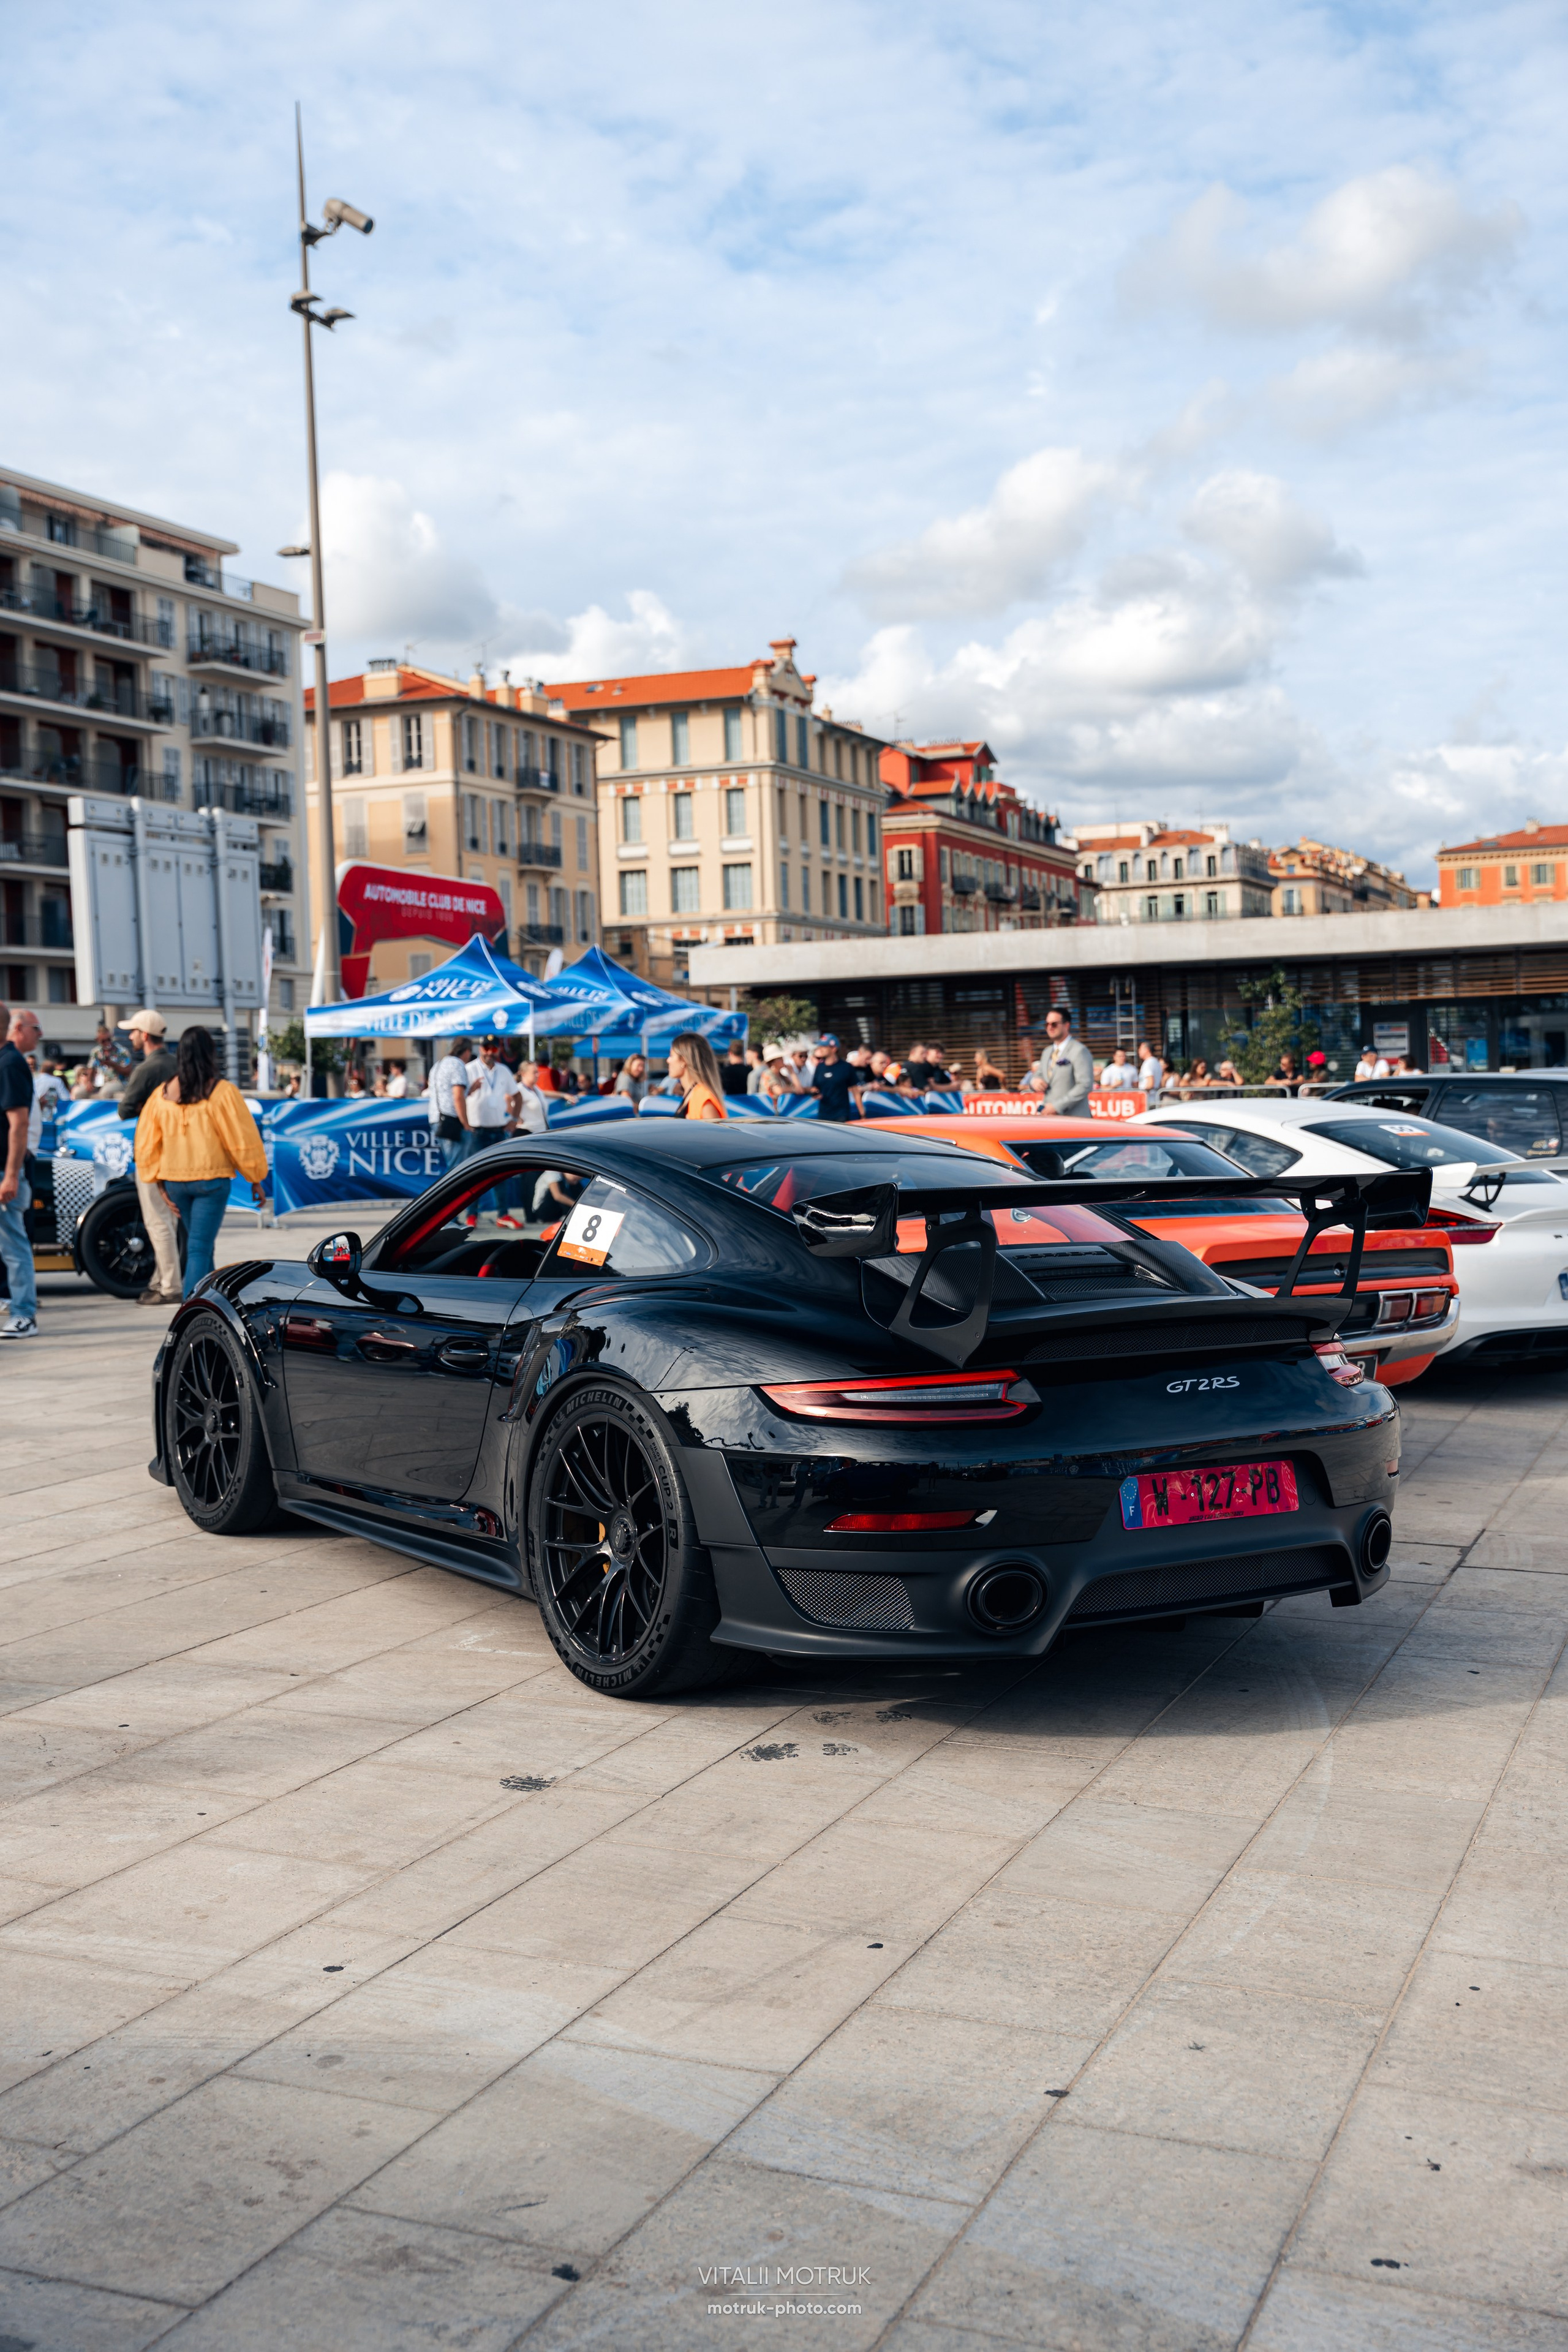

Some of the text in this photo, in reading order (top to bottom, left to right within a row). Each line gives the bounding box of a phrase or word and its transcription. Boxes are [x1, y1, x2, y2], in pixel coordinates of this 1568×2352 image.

[363, 883, 487, 915] AUTOMOBILE CLUB DE NICE
[963, 1100, 1045, 1114] UTOMO
[345, 1129, 441, 1148] VILLE DE
[348, 1147, 440, 1177] NICE
[582, 1215, 601, 1242] 8
[566, 1391, 623, 1414] MICHELIN
[649, 1445, 659, 1463] SPORT
[652, 1442, 662, 1461] PILOT
[658, 1464, 677, 1540] CUP 2 R
[1129, 1506, 1136, 1517] F
[575, 1665, 633, 1687] MICHELIN
